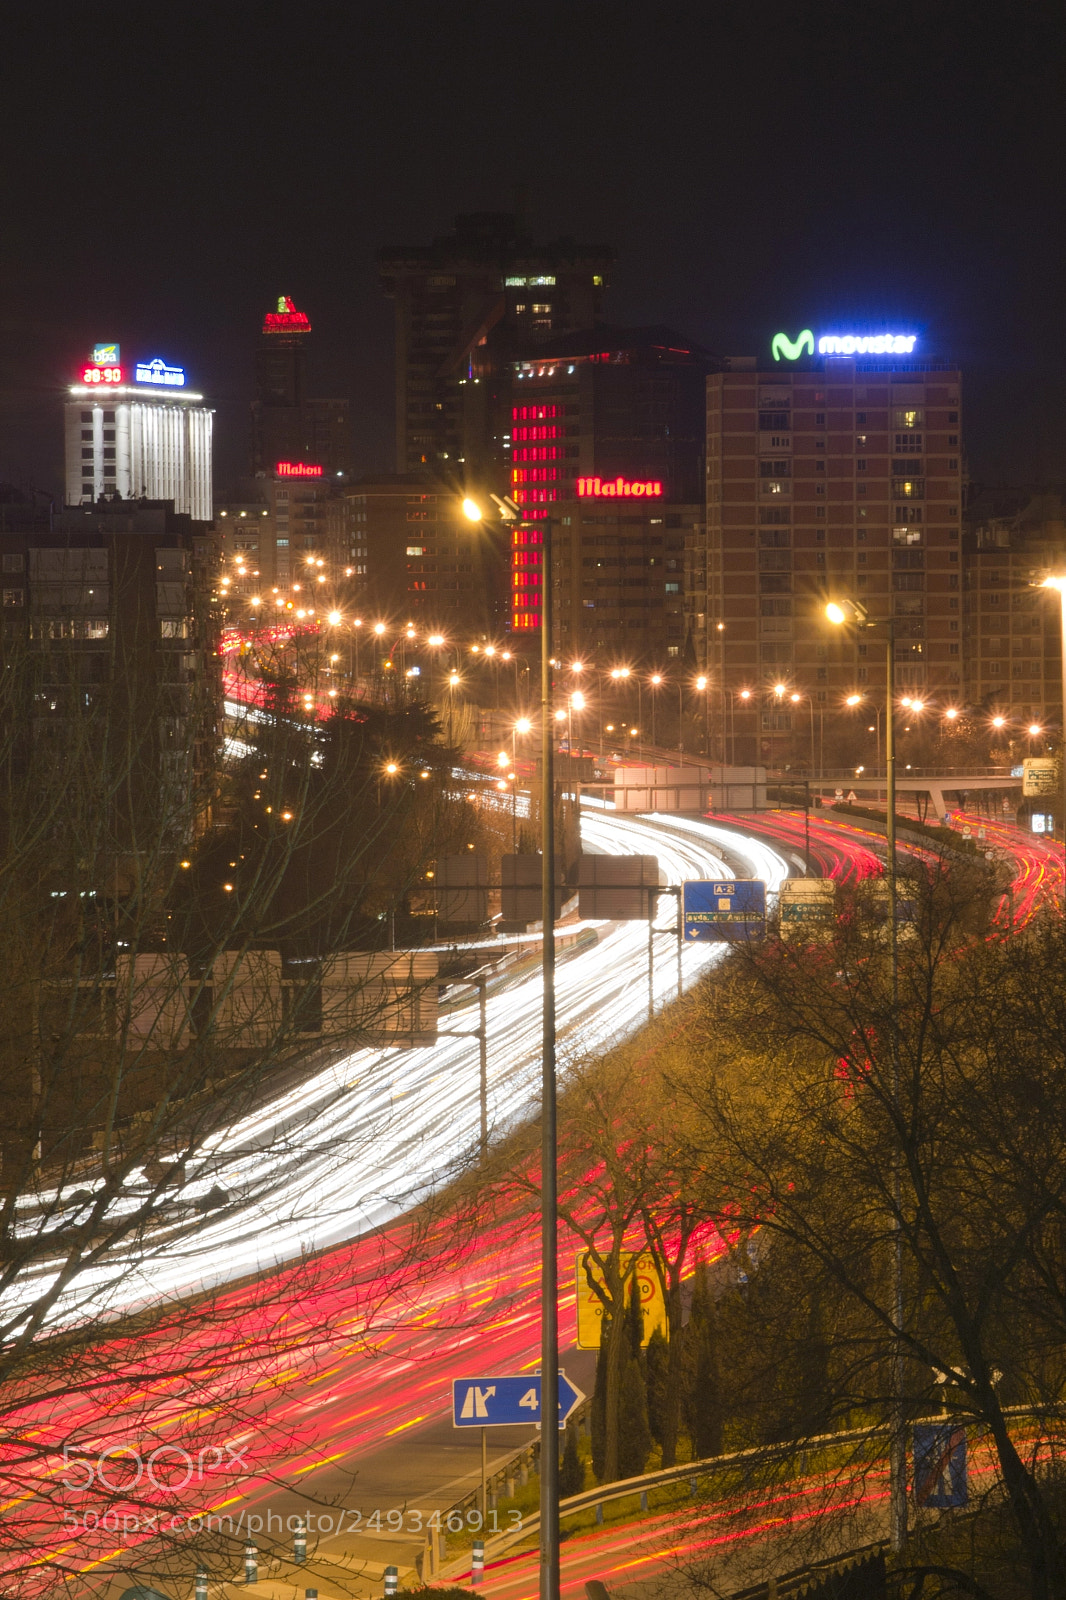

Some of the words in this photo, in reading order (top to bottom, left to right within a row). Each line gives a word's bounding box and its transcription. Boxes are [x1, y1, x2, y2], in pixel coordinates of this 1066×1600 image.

[818, 333, 917, 354] movistar
[88, 349, 117, 362] abba
[277, 461, 323, 476] Mahou
[577, 477, 663, 497] Mahou
